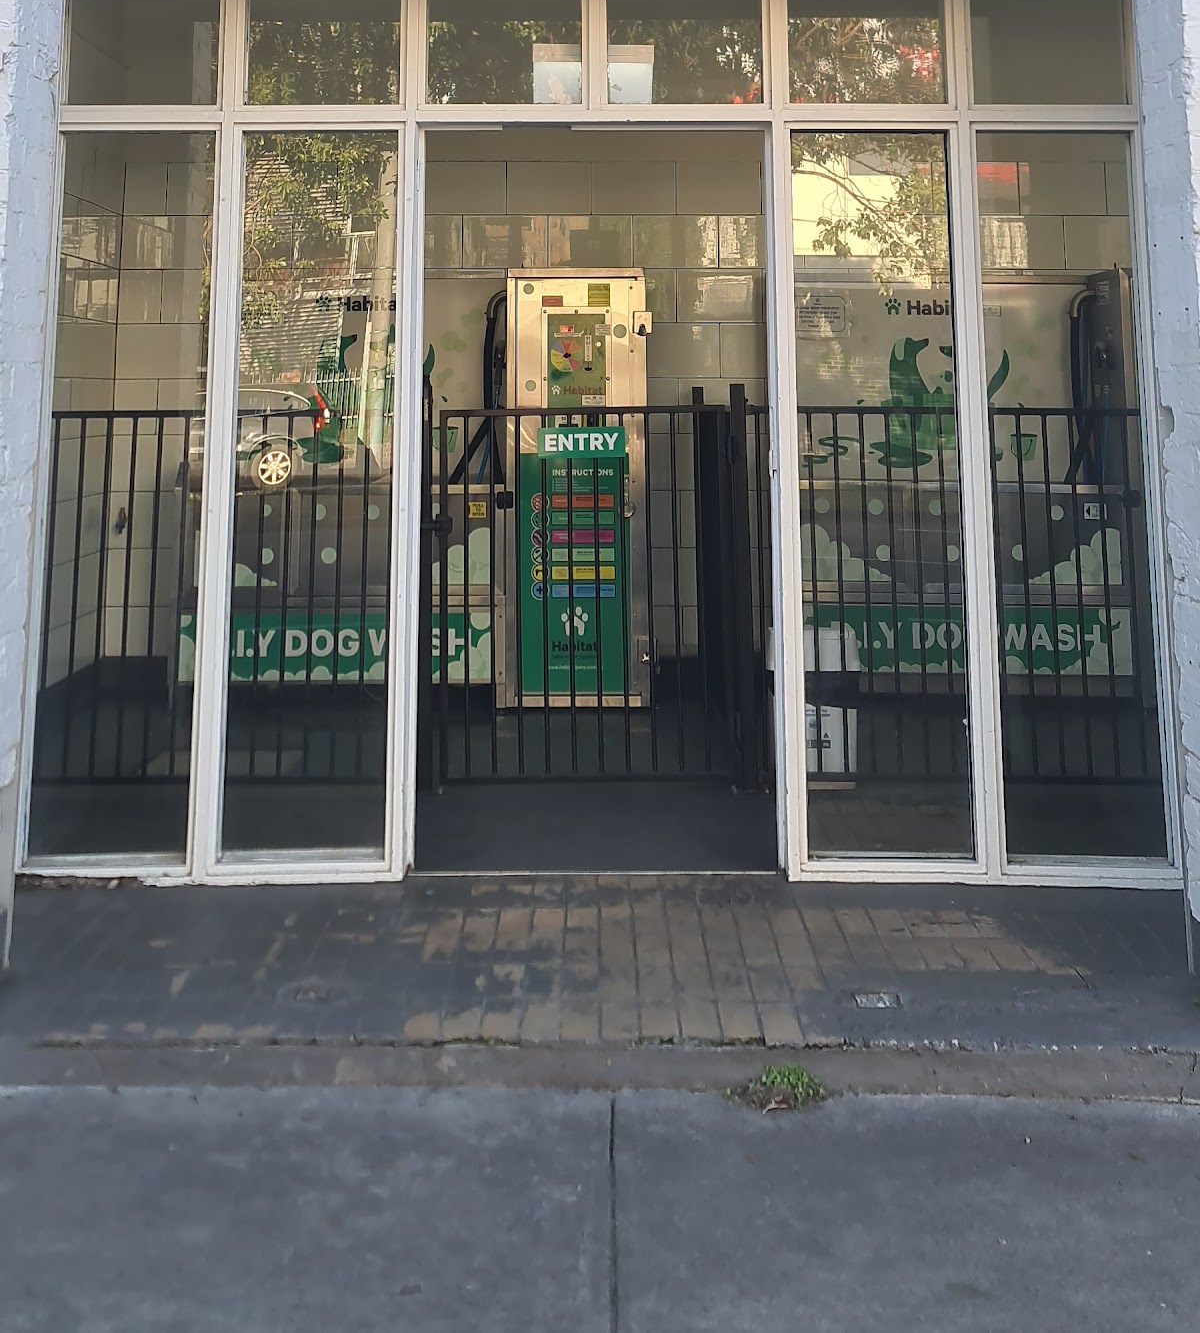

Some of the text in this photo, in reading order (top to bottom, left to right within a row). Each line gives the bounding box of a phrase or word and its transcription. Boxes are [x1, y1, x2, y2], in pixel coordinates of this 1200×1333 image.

[337, 295, 397, 312] Habita
[906, 299, 950, 316] Habi
[563, 385, 603, 395] Habitat
[544, 432, 619, 452] ENTRY
[552, 468, 614, 477] INSRUCTONS
[285, 628, 360, 658] DOG
[912, 622, 964, 650] DO
[997, 623, 1101, 652] WASH
